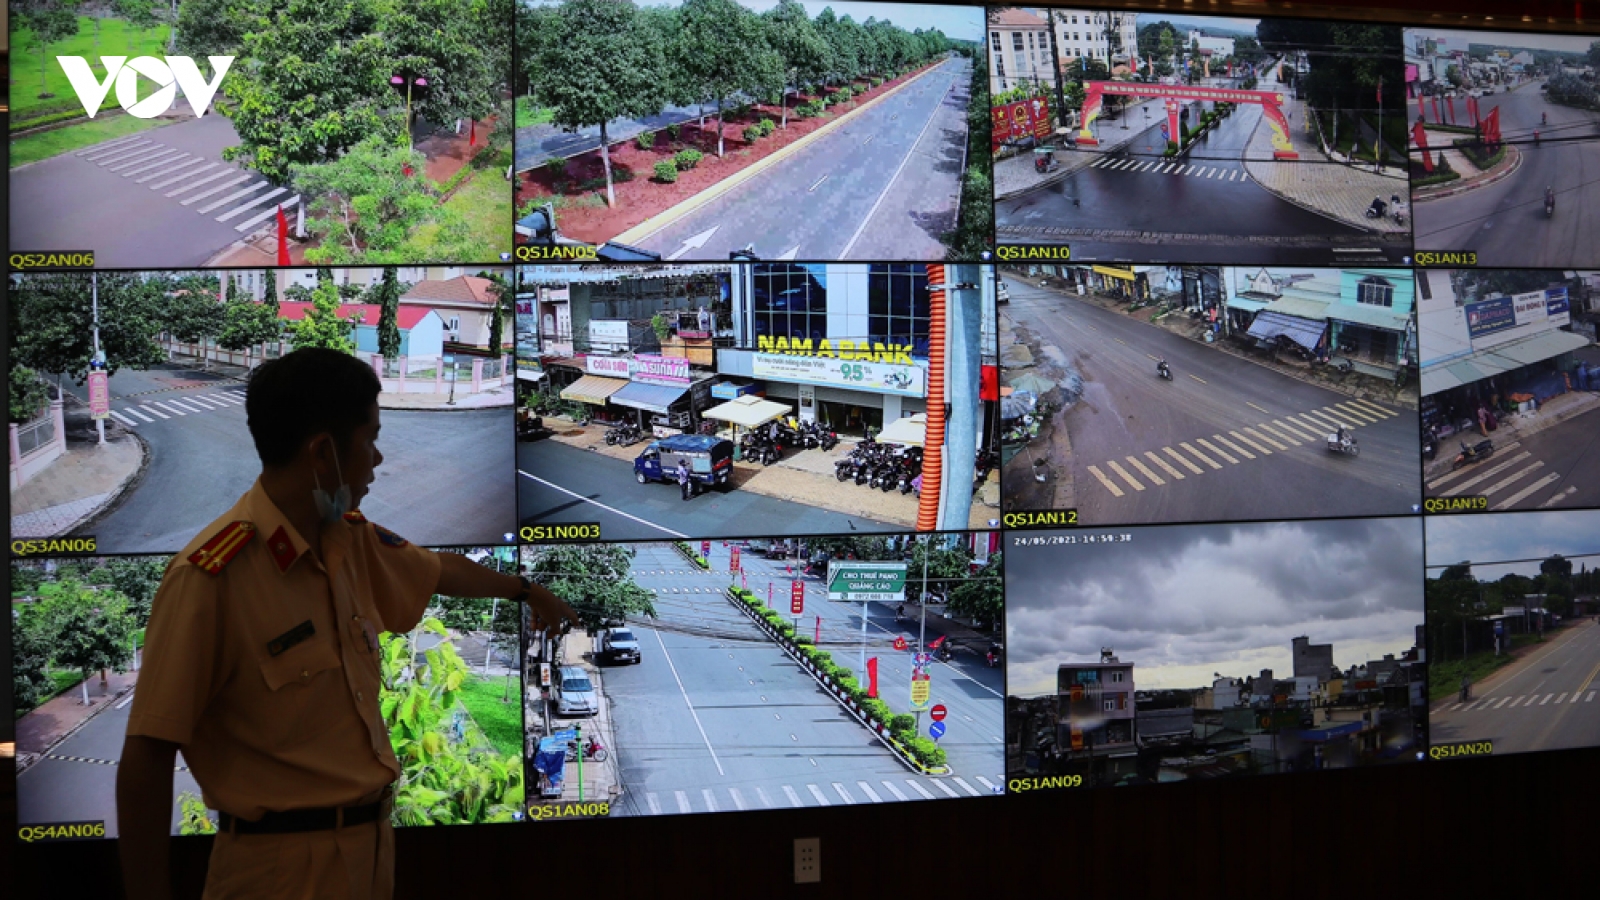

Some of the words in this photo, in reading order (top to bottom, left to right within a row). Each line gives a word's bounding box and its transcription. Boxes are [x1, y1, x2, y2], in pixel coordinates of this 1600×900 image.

[10, 253, 95, 269] QS2AN06
[516, 245, 597, 261] QS1AN05
[996, 246, 1070, 261] QS1AN10
[1415, 252, 1477, 266] QS1AN13
[757, 334, 813, 357] NAM
[816, 338, 835, 359] A
[837, 340, 914, 366] BANK
[1425, 497, 1487, 512] QS1AN19
[1004, 511, 1077, 528] QS1AN12
[520, 525, 601, 542] QS1N003
[12, 538, 96, 556] QS3AN06
[1430, 742, 1493, 759] QS1AN20
[1009, 774, 1083, 793] QS1AN09
[529, 802, 610, 821] QS1AN08
[19, 823, 105, 842] QS4AN06
